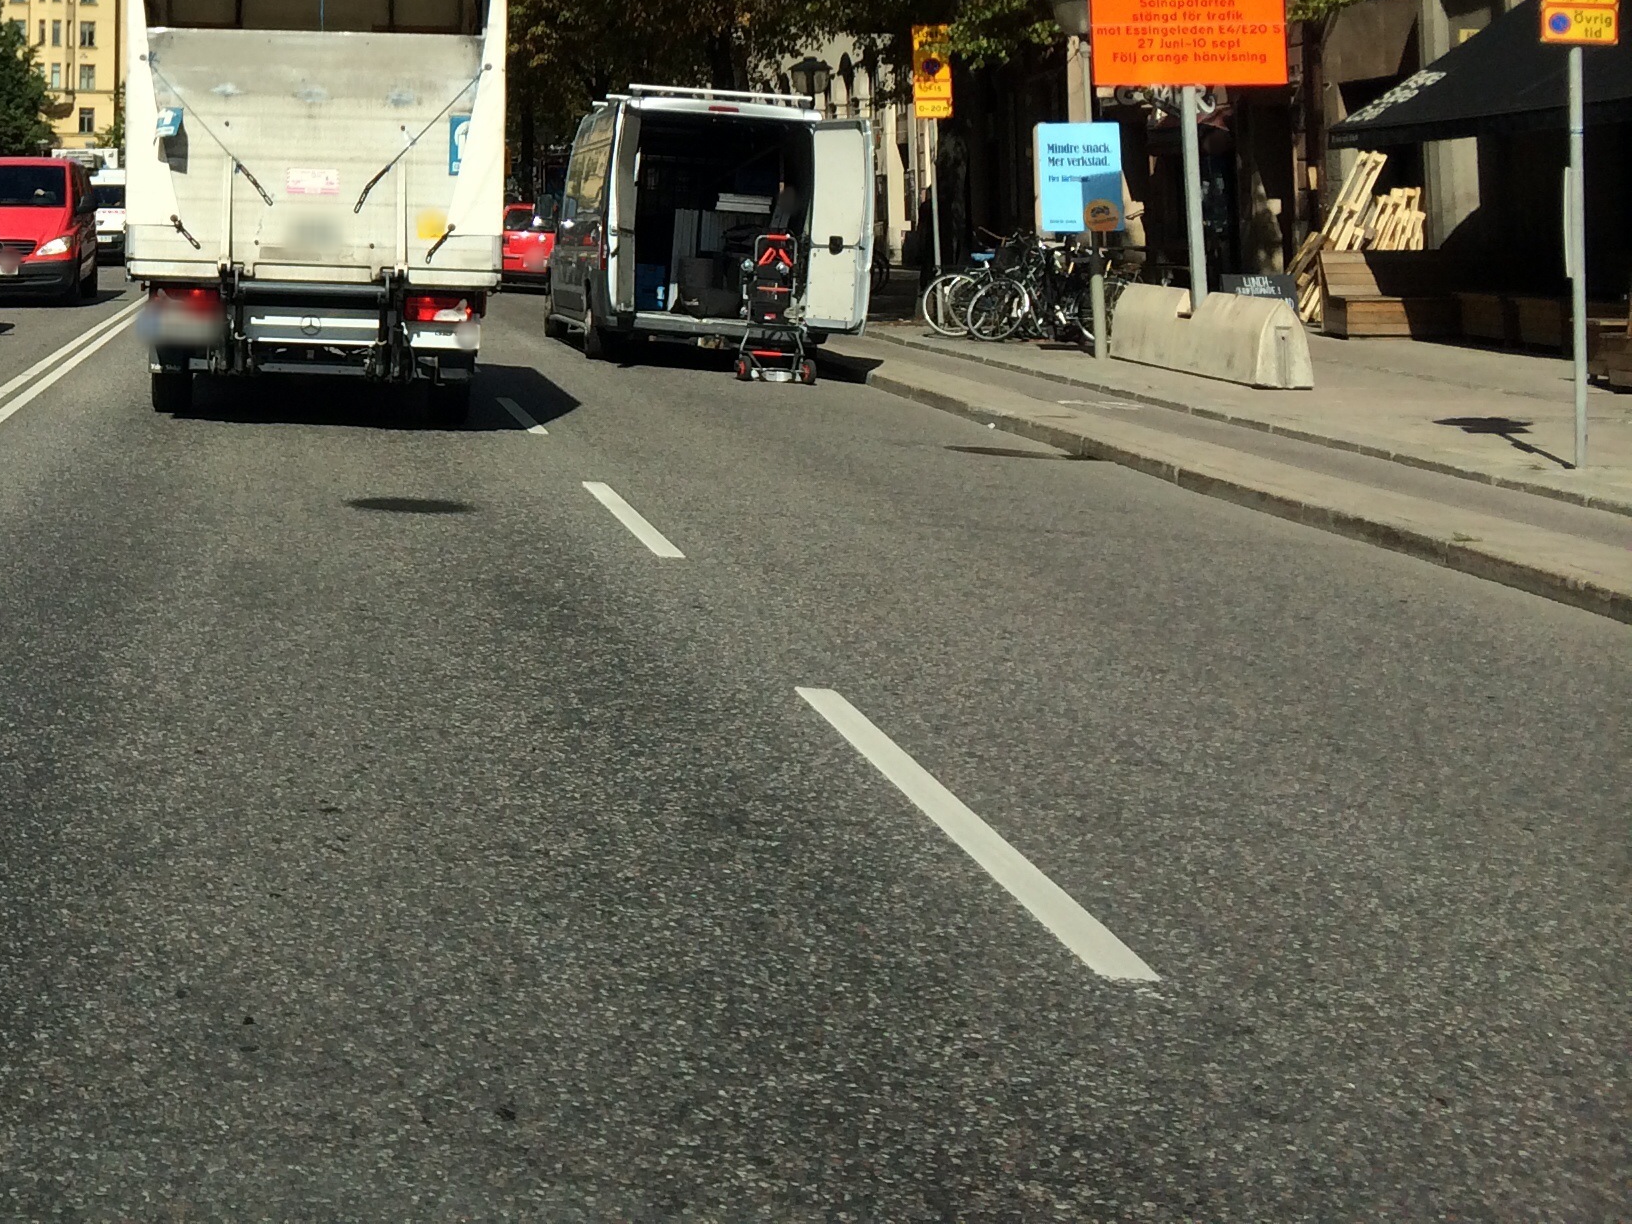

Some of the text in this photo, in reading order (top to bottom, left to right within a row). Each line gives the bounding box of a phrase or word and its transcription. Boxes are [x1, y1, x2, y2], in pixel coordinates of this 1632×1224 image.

[1132, 11, 1244, 23] stängd för trafik
[1574, 10, 1612, 28] Övrig
[1097, 23, 1282, 37] mot Essingeleden E4/E20 S
[1584, 27, 1602, 38] tid
[1137, 39, 1154, 49] 27
[1211, 39, 1241, 51] sept
[1113, 52, 1267, 64] Följ orange hänvisning
[1047, 143, 1079, 154] Mindre
[1047, 156, 1111, 167] Mer verkstad.
